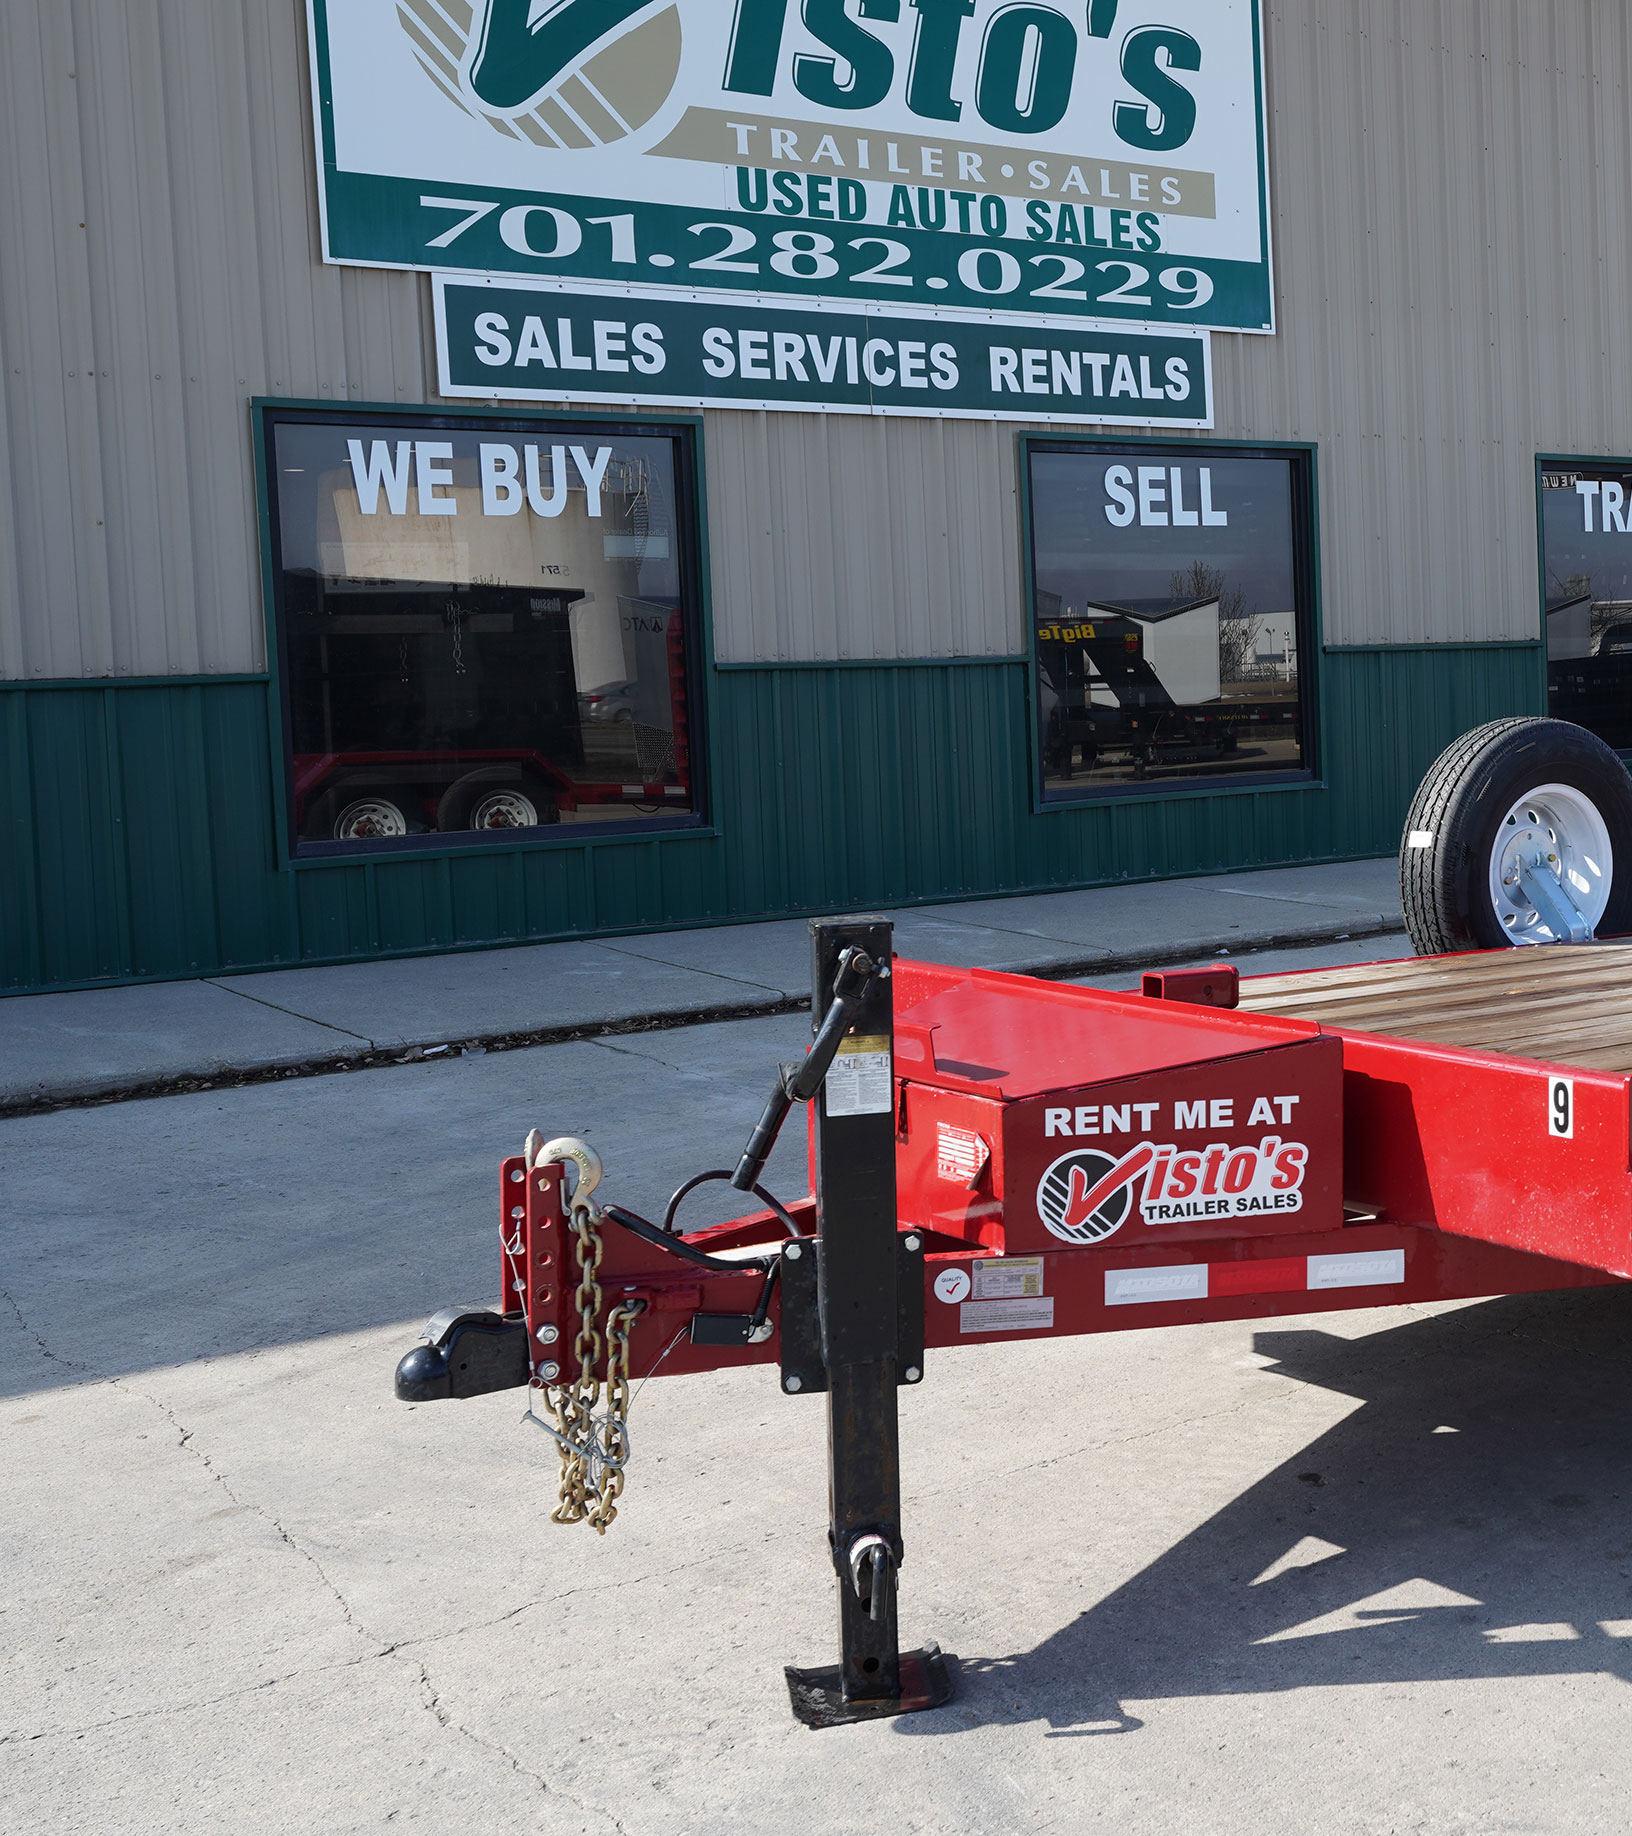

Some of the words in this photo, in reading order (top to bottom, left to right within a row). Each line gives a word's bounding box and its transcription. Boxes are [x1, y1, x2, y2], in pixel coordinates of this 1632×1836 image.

[736, 165, 867, 224] USED
[886, 181, 1011, 239] AUTO
[1024, 200, 1162, 254] SALES
[418, 195, 1216, 311] 701.282.0229
[472, 310, 667, 376] SALES
[701, 326, 961, 392] SERVICES
[988, 345, 1192, 402] RENTALS
[347, 439, 457, 516] WE
[479, 442, 613, 518] BUY
[1104, 464, 1228, 528] SELL
[1044, 1102, 1160, 1137] RENT
[1174, 1098, 1234, 1130] ME
[1247, 1095, 1300, 1126] AT
[1554, 1081, 1570, 1134] 9
[1064, 1139, 1304, 1226] Visto's
[1145, 1199, 1230, 1220] TRAILER
[1236, 1193, 1298, 1212] SALES
